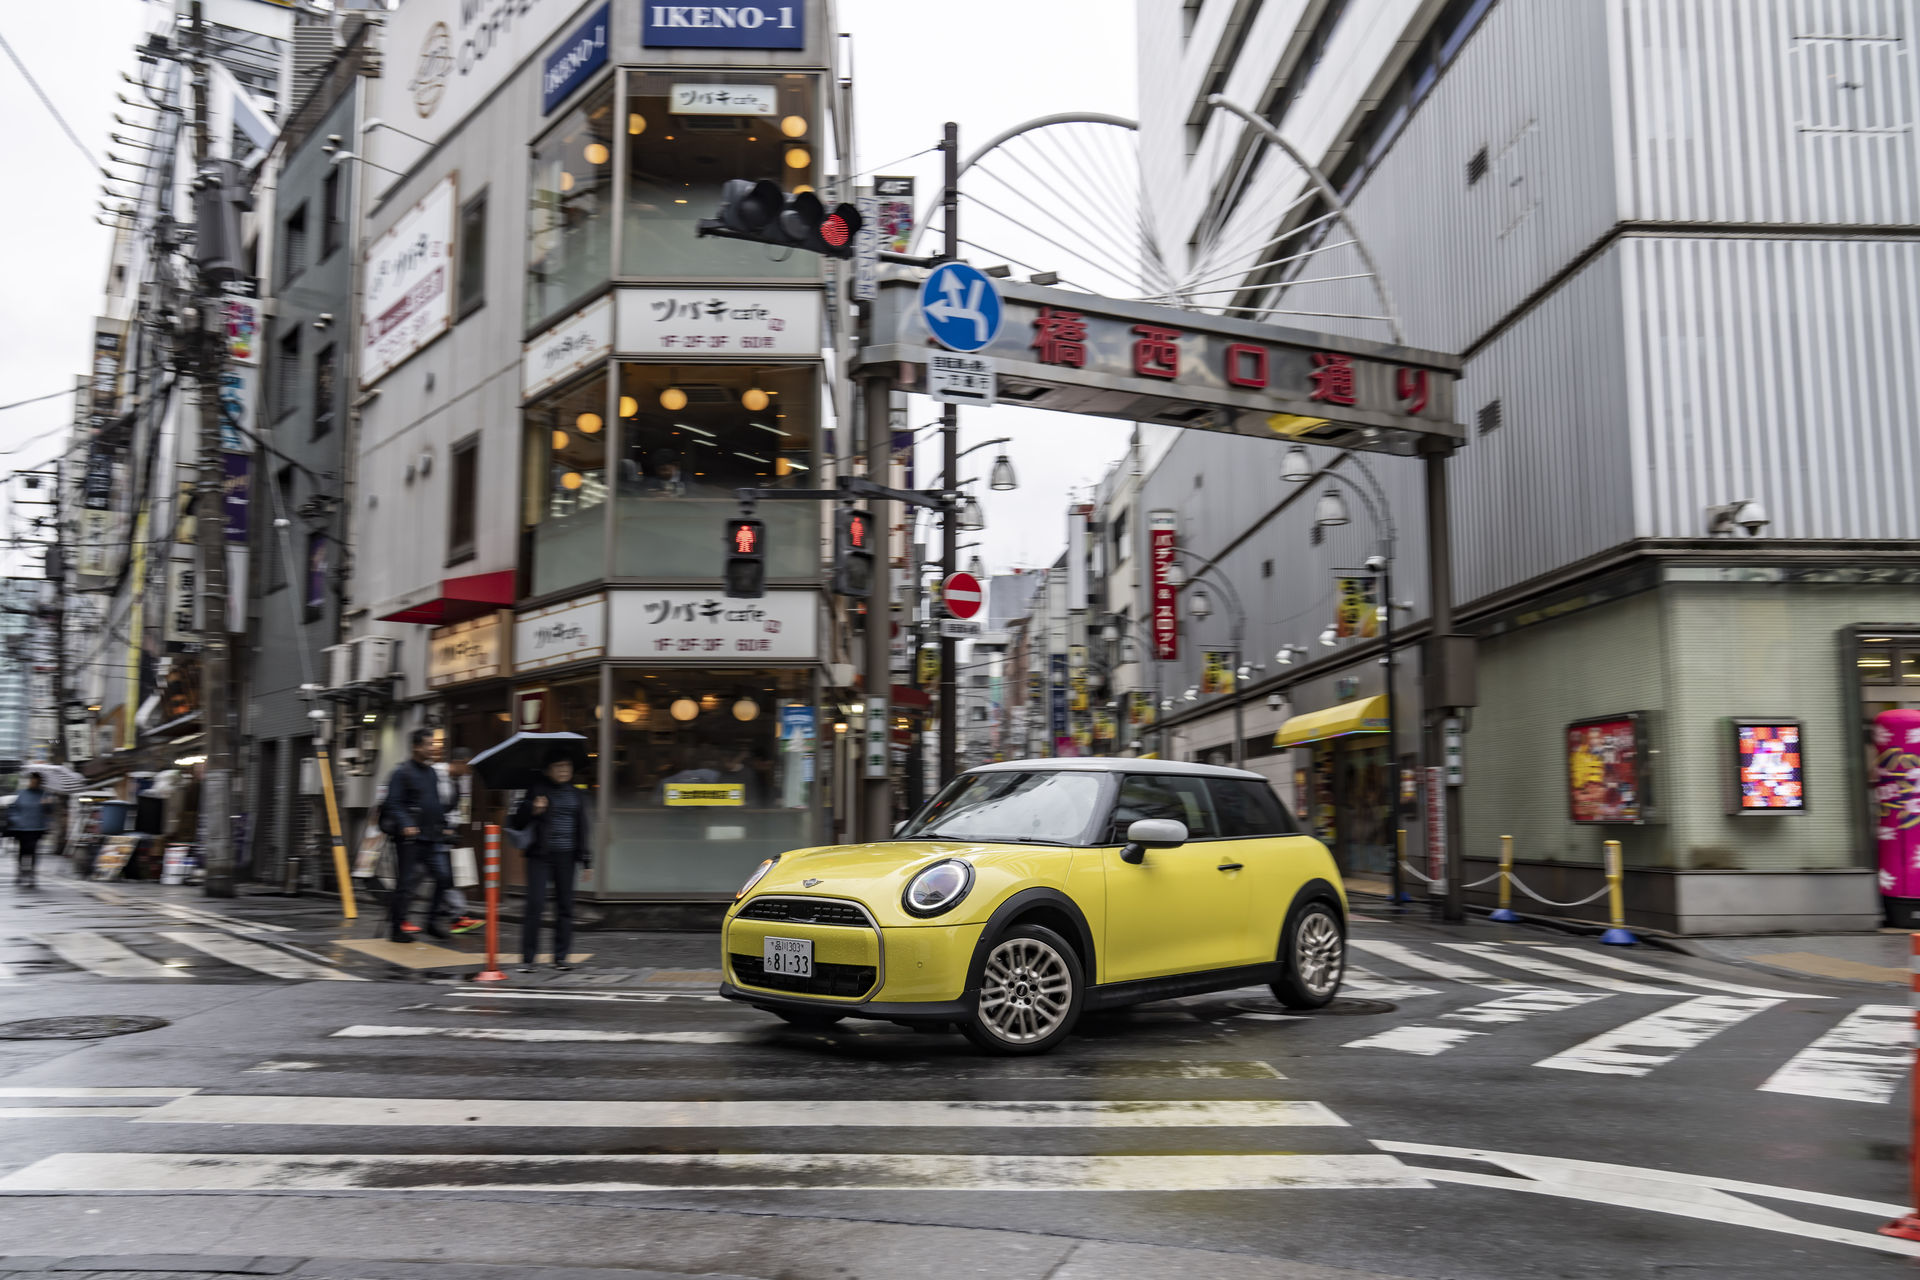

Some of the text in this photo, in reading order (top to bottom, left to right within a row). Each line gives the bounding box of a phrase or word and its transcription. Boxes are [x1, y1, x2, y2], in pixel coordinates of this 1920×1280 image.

[651, 6, 796, 28] IKENO-1
[1031, 306, 1430, 414] 橋西口通り
[789, 941, 801, 952] 303
[774, 952, 809, 974] 81-33
